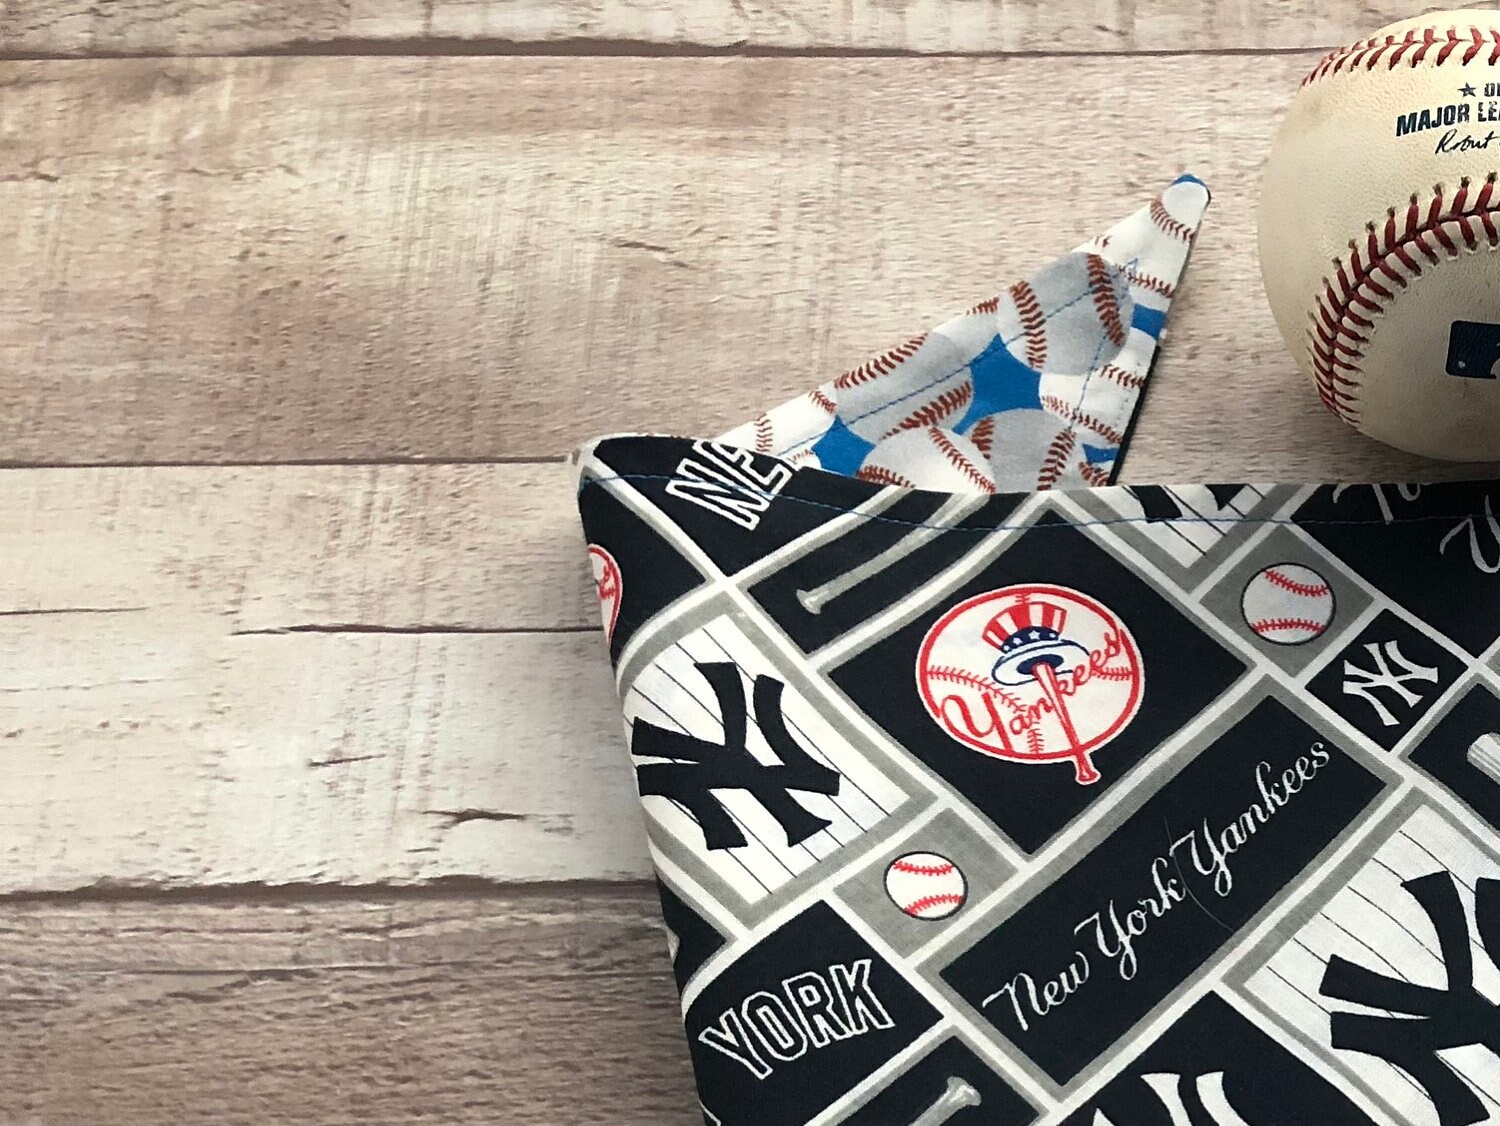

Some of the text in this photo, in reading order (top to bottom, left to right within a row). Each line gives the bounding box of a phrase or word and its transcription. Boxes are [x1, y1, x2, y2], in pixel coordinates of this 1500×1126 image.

[1396, 103, 1470, 137] MAJOR
[934, 629, 1123, 755] Yankees
[982, 741, 1330, 1031] New York Yankees
[698, 959, 896, 1081] YORK
